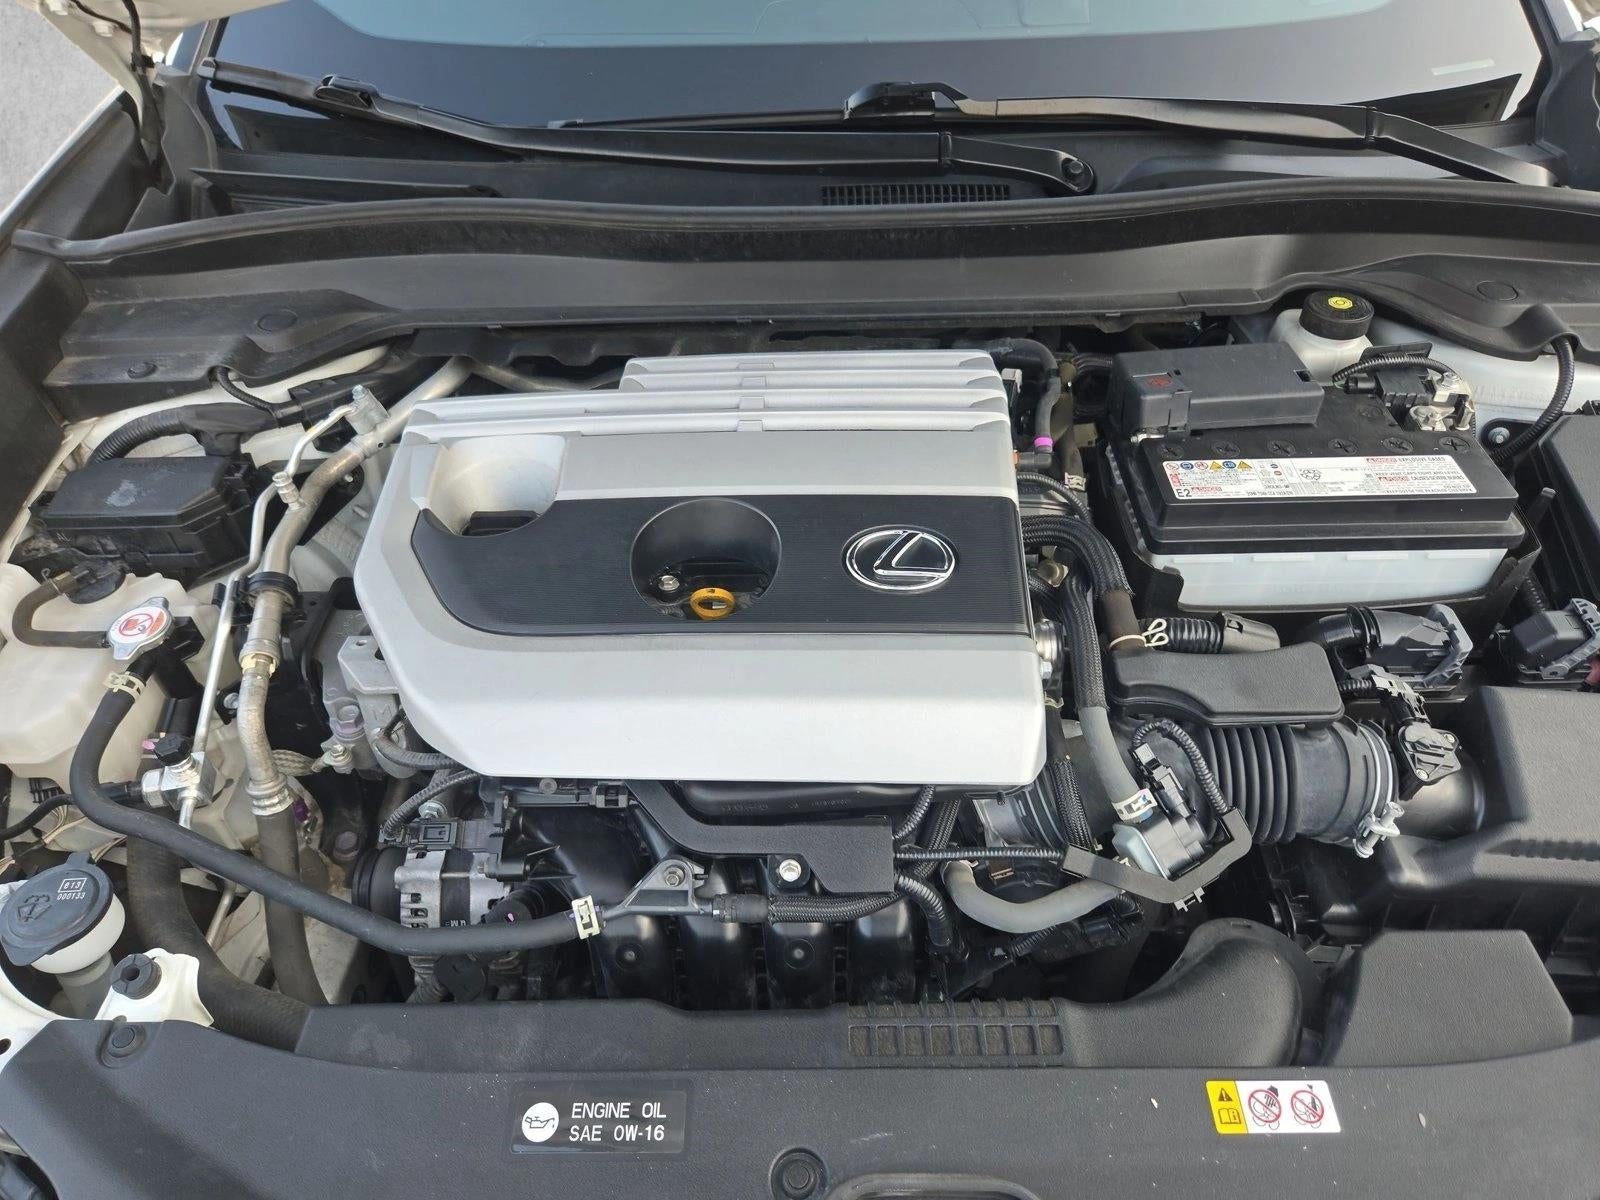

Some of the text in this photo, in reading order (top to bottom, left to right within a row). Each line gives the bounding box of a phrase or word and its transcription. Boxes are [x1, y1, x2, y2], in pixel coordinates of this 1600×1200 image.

[1176, 489, 1192, 498] E2
[56, 892, 86, 901] 000133
[571, 1101, 667, 1118] ENGINE OIL
[568, 1124, 666, 1141] SAE 0W-16
